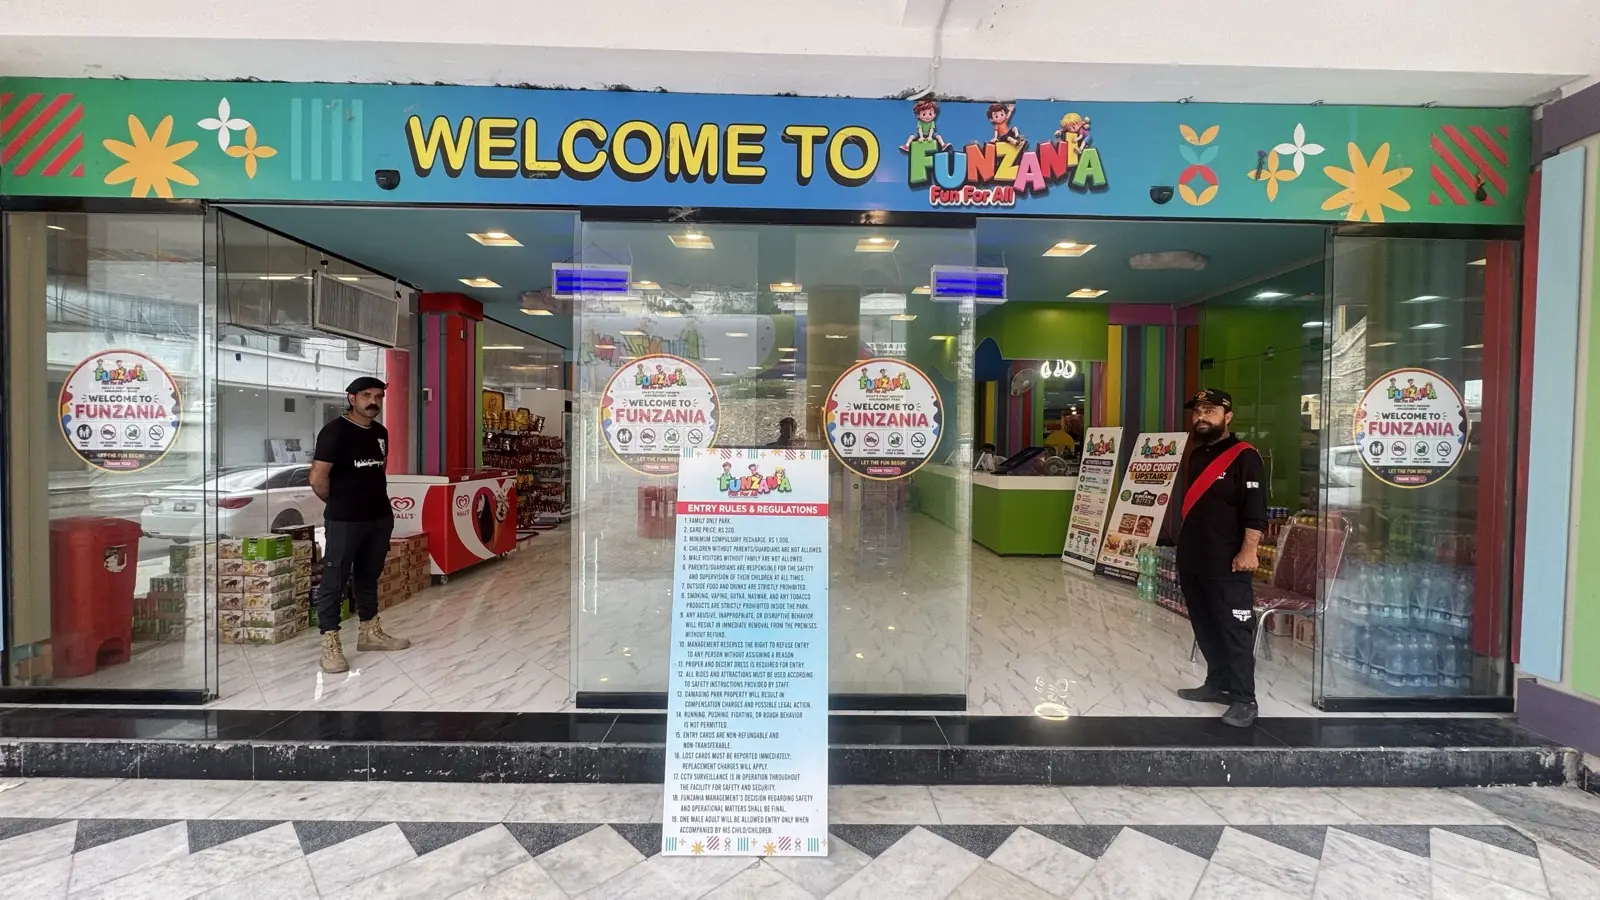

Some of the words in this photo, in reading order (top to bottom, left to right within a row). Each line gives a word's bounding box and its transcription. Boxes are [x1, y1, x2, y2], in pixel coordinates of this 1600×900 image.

[407, 115, 767, 184] WELCOME
[784, 125, 881, 188] TO
[909, 132, 1109, 196] FUNZANIA
[930, 185, 961, 205] Fun
[963, 186, 990, 206] For
[993, 187, 1015, 206] All
[75, 404, 167, 419] FUNZANIA
[616, 408, 705, 423] FUNZANIA
[840, 413, 928, 427] FUNZANIA
[1369, 422, 1454, 435] FUNZANIA
[1132, 463, 1151, 472] FOOD
[1153, 463, 1176, 472] COURT
[720, 473, 791, 494] FUNZANIA
[688, 504, 717, 512] ENTRY
[719, 504, 747, 513] RULES
[749, 505, 756, 513] &
[757, 505, 818, 514] REGULATIONS
